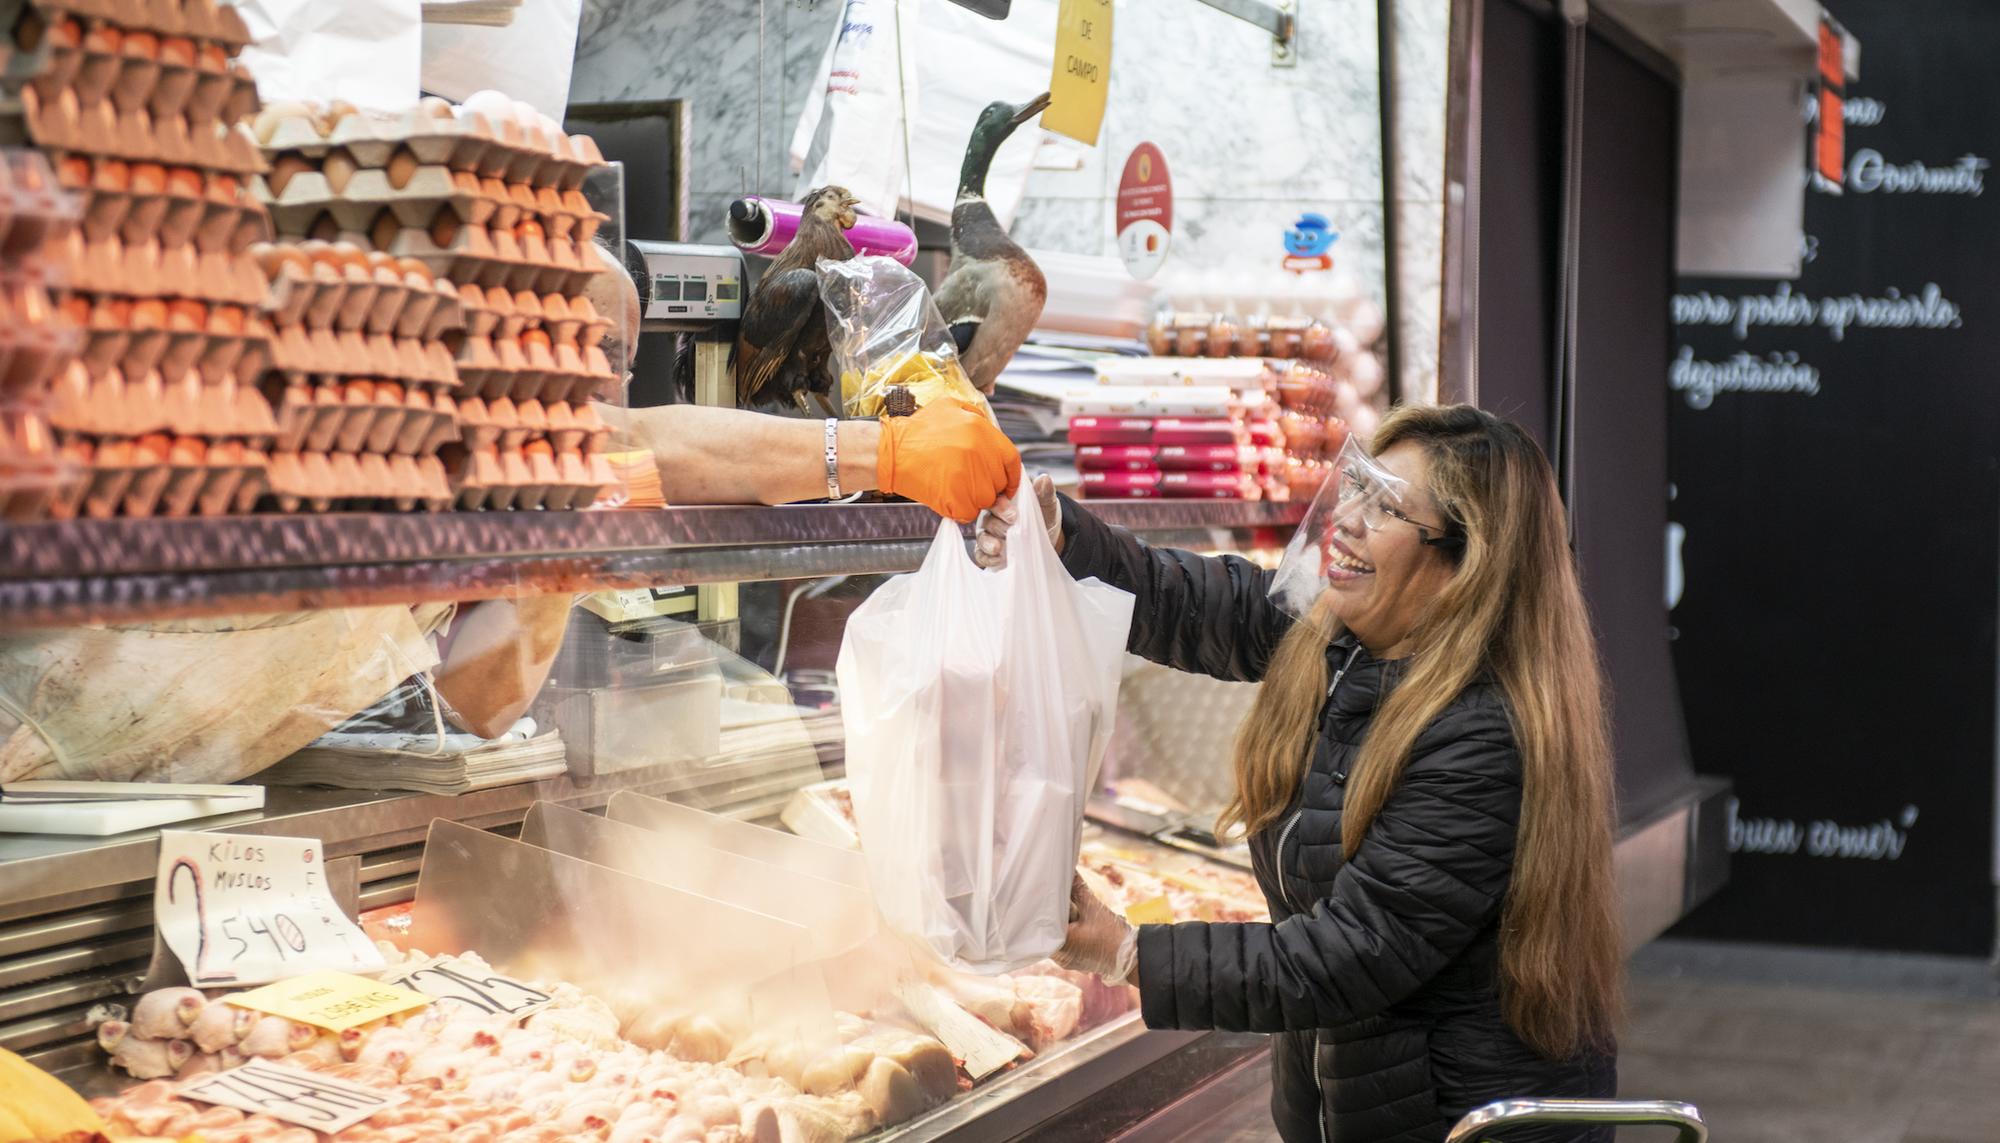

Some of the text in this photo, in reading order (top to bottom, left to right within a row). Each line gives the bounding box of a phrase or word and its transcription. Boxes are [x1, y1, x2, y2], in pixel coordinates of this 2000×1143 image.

[1081, 19, 1094, 40] DE
[1067, 54, 1099, 84] CAMPO
[1733, 281, 1818, 340] poder
[1727, 795, 1804, 854] buen
[213, 871, 273, 892] MUSLOS
